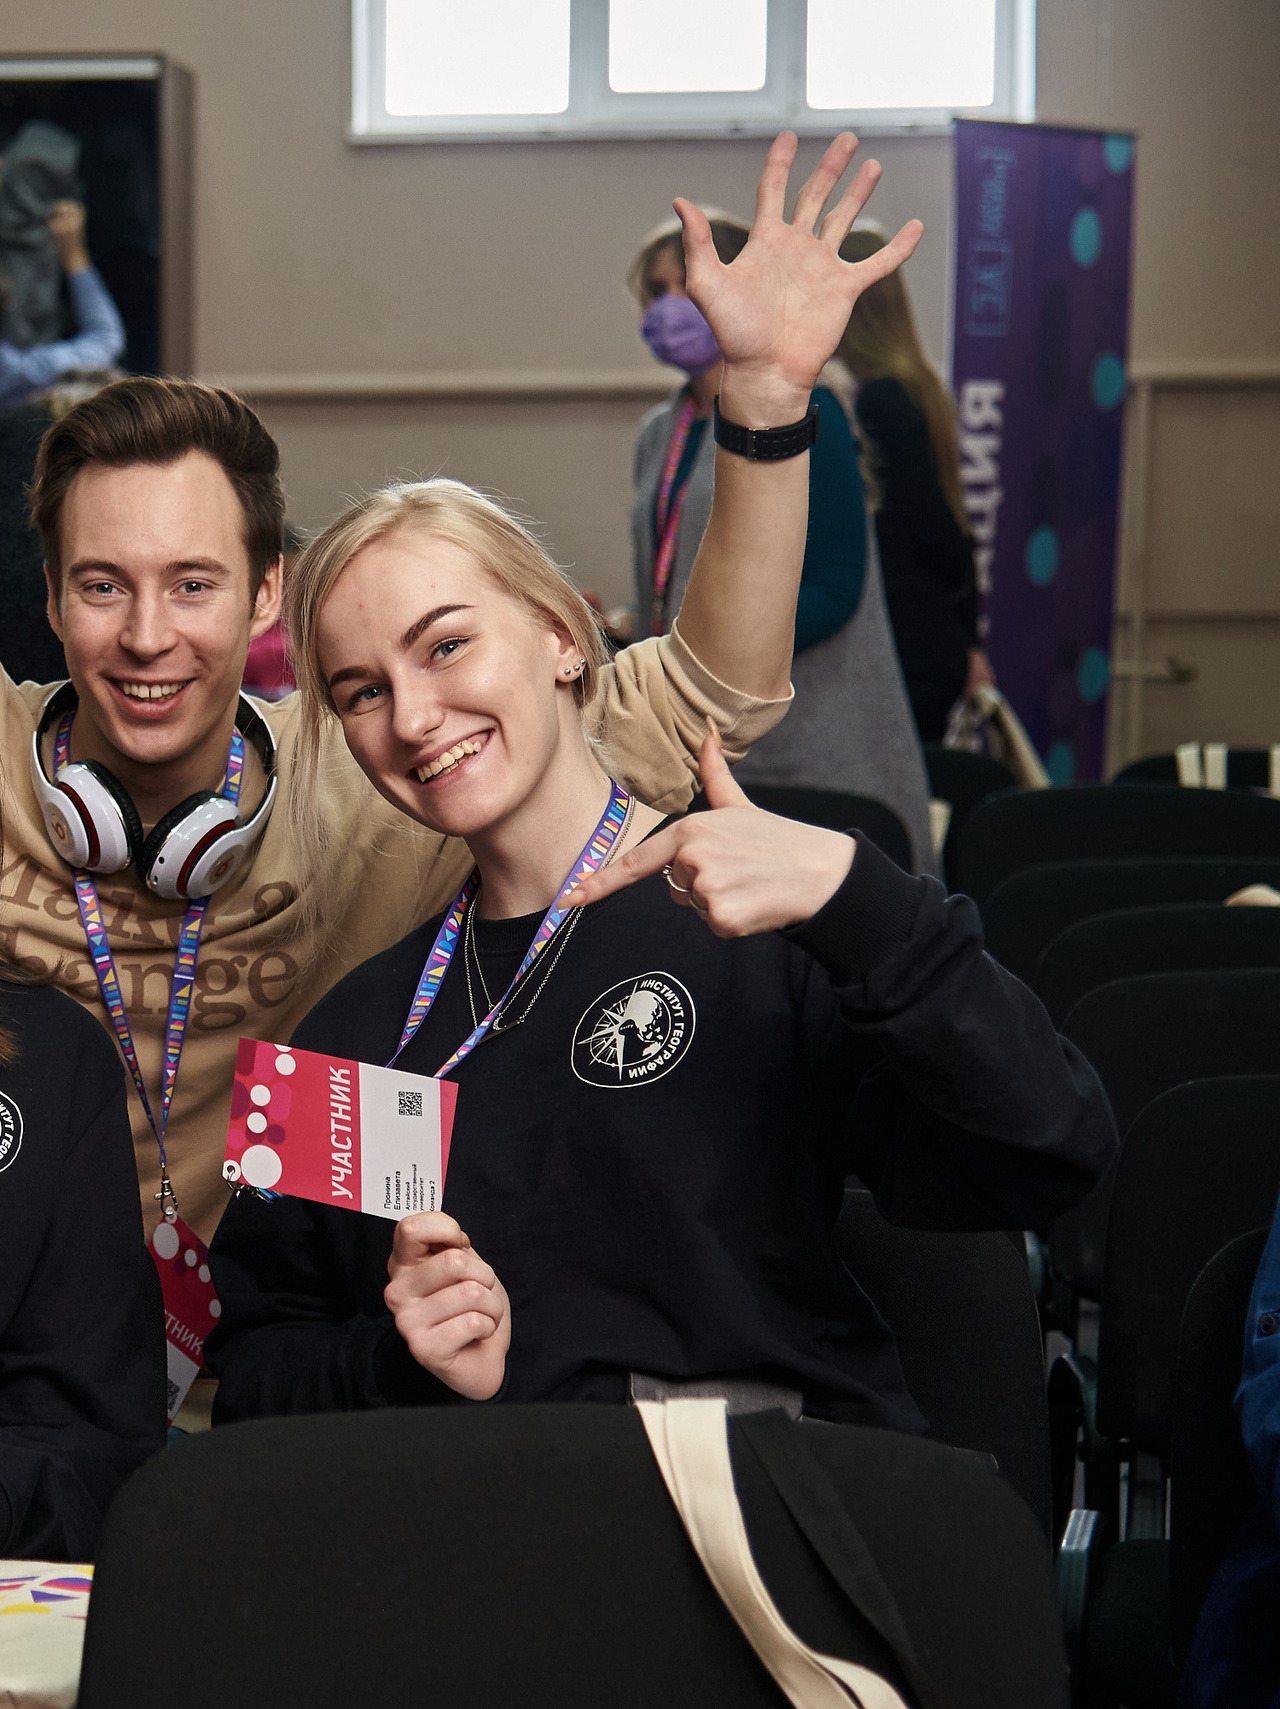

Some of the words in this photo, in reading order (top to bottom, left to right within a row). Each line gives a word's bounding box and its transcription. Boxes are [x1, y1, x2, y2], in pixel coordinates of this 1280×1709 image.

[640, 979, 685, 1018] ИНСТИТУТ
[628, 1022, 685, 1079] ГЕОГРАФИИ
[328, 1065, 354, 1200] УЧАСТНИК
